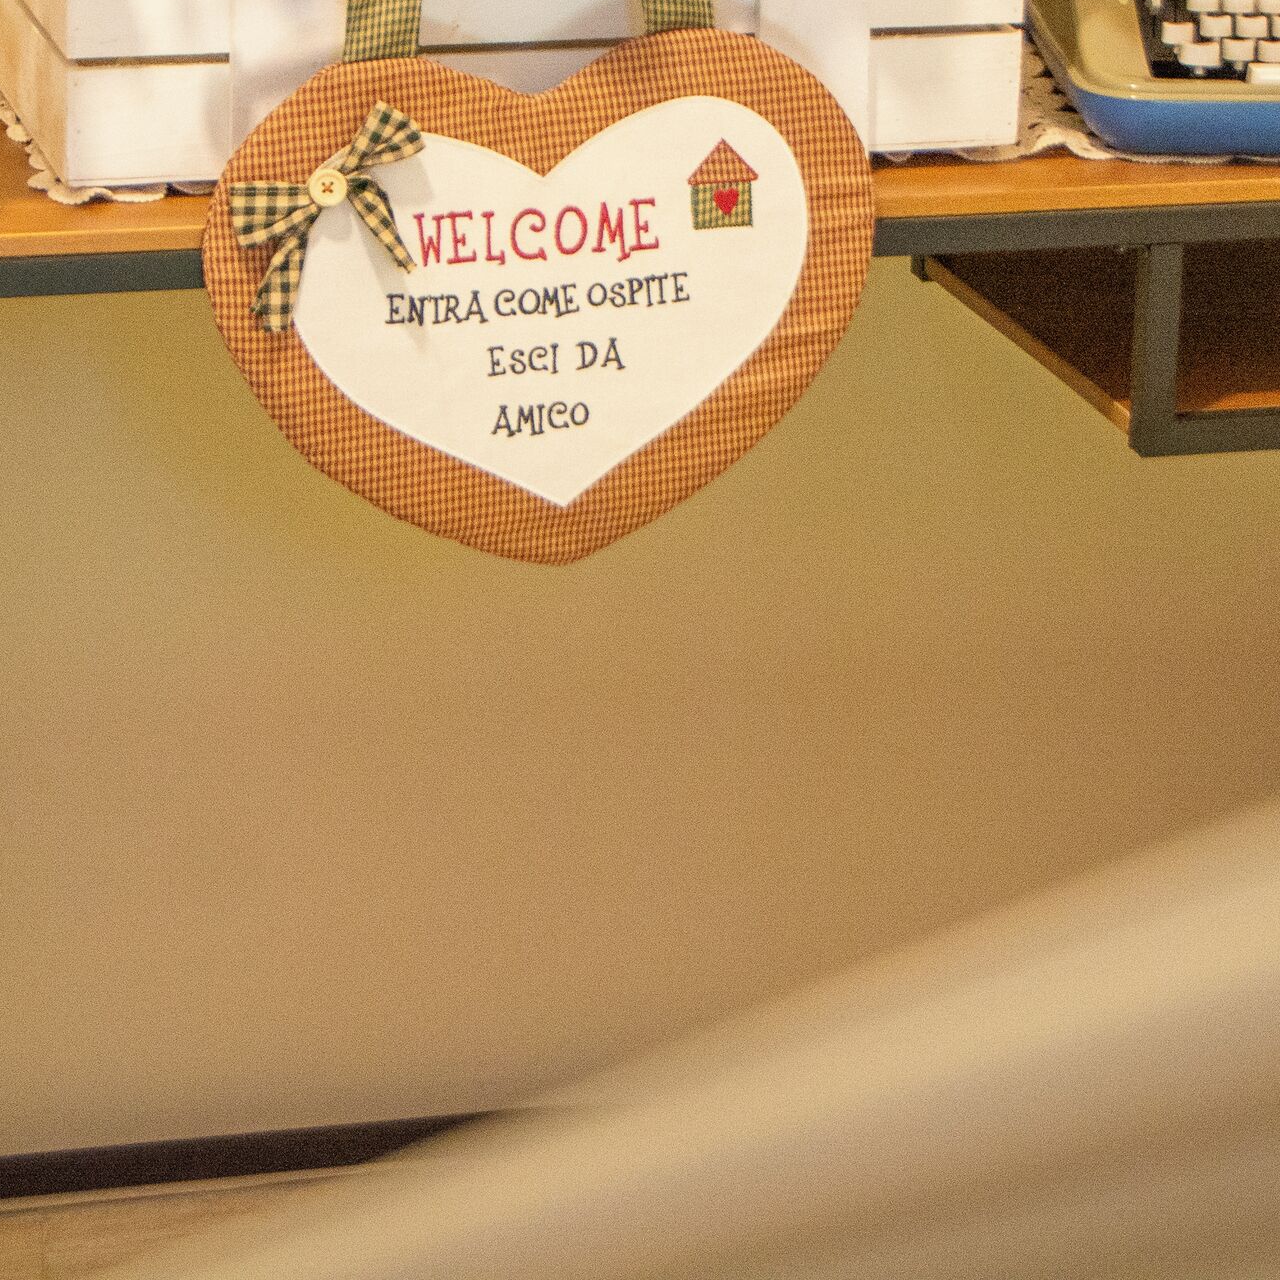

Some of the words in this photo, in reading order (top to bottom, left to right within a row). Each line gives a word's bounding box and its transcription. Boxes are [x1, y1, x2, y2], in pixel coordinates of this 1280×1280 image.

[412, 197, 660, 268] WELCOME
[384, 289, 489, 327] ENTRA
[493, 283, 580, 318] COME
[586, 271, 690, 308] OSPITE
[486, 342, 560, 377] ESCI
[575, 336, 626, 371] DA
[490, 401, 590, 438] AMICO
